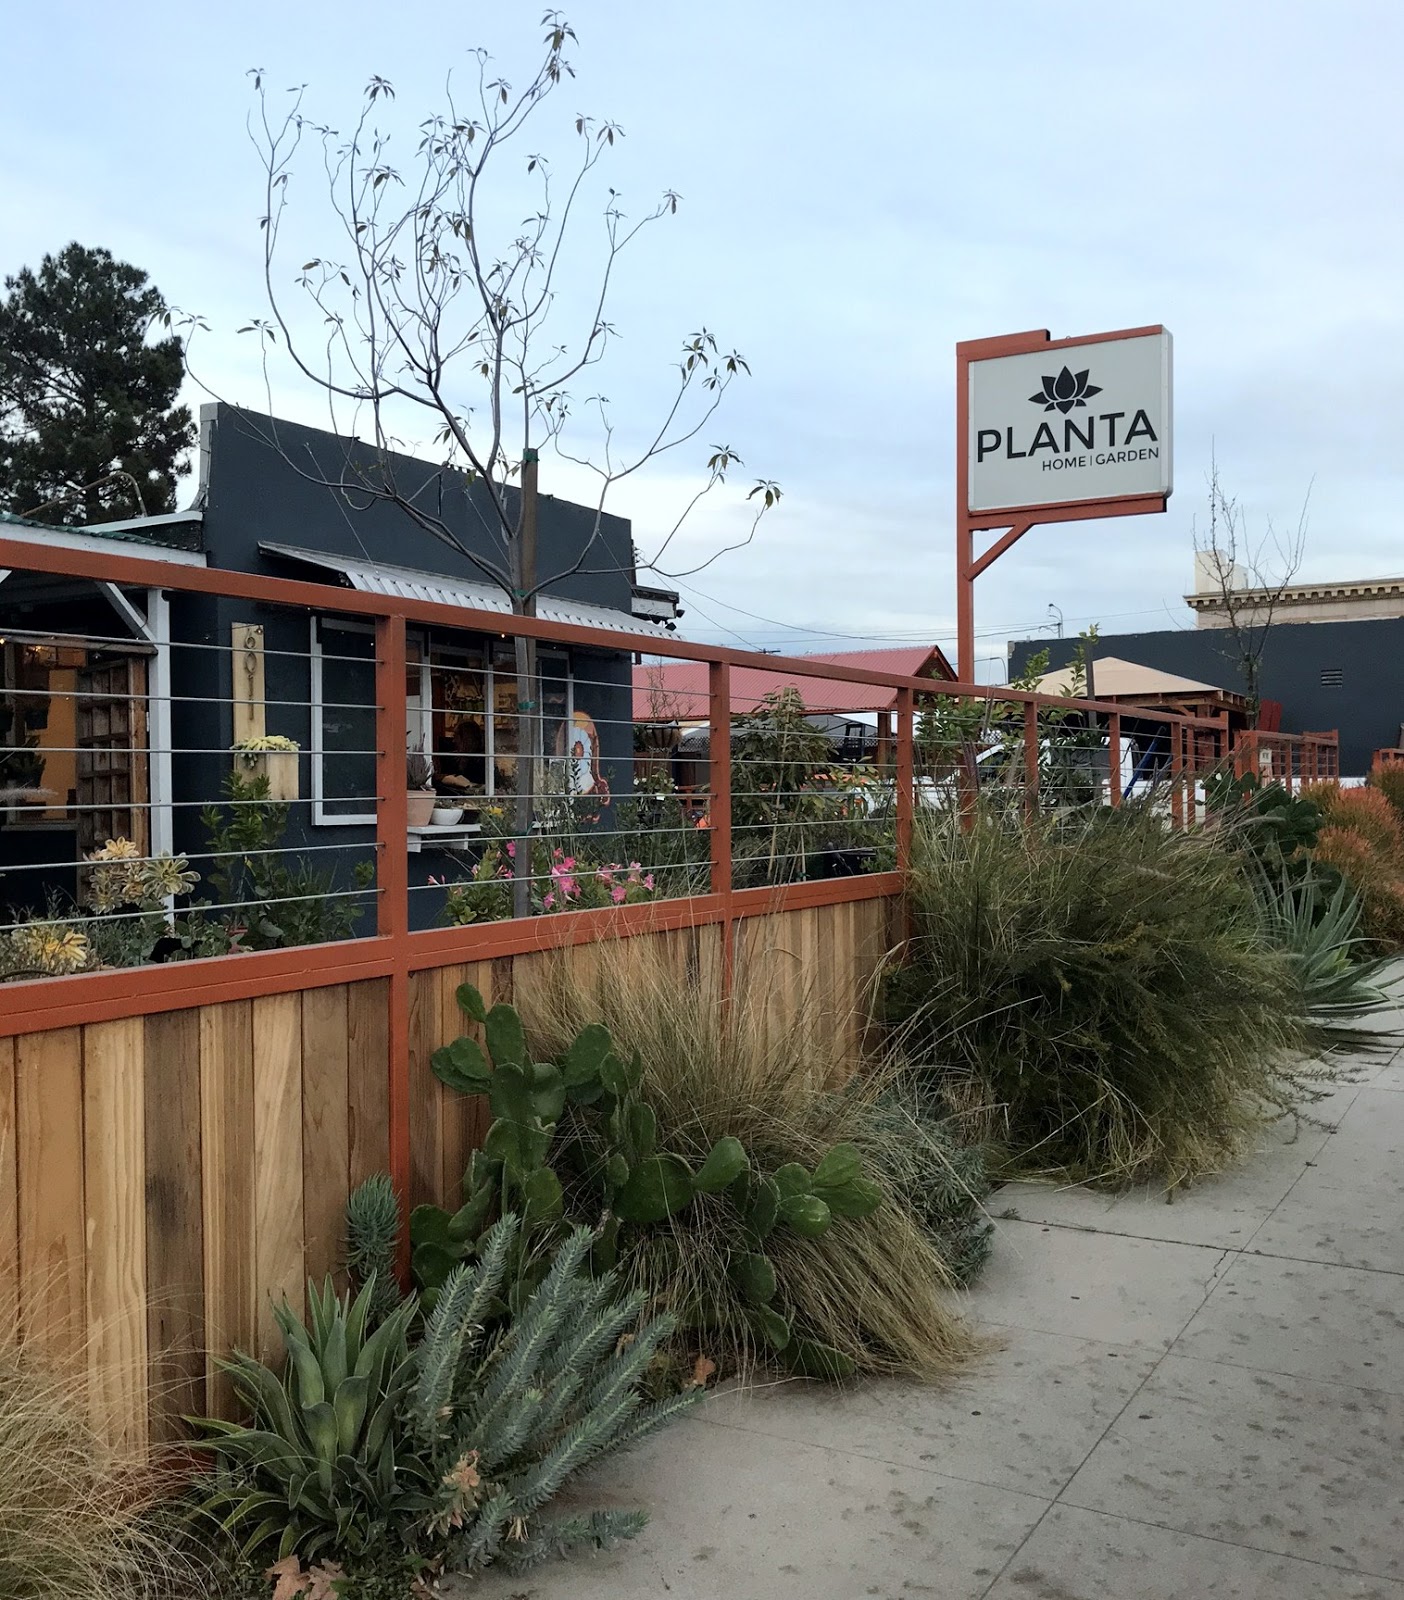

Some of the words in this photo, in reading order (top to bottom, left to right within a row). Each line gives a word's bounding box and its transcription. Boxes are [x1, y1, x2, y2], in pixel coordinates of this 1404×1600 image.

[977, 409, 1159, 463] PLANTA
[1042, 455, 1087, 472] HOME
[1095, 447, 1160, 466] GARDEN
